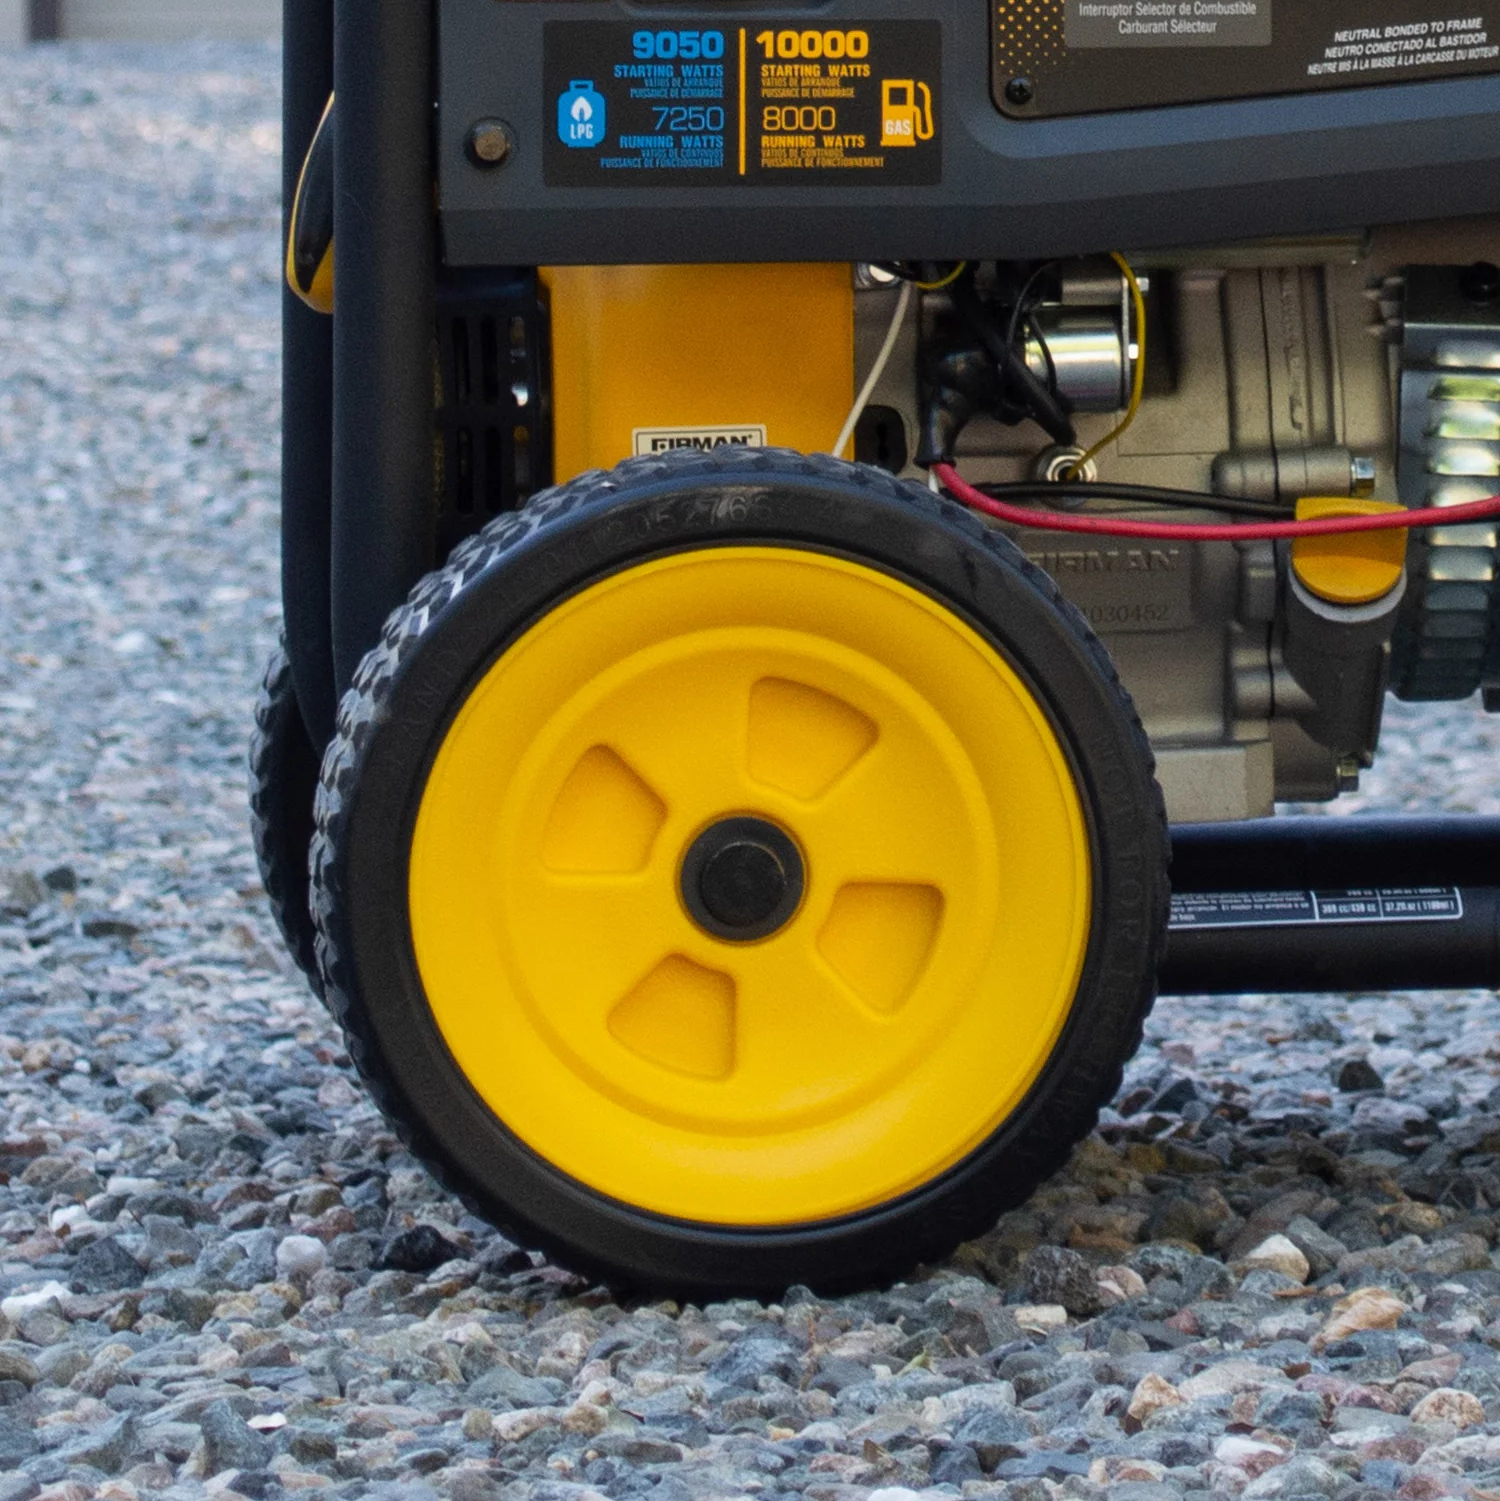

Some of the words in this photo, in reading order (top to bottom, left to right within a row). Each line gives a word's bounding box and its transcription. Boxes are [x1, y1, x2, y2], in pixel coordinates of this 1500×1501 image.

[1079, 3, 1133, 18] Interruptor
[1135, 3, 1177, 16] Selector
[1179, 2, 1192, 16] de
[1193, 1, 1257, 16] Combustible
[1118, 20, 1168, 34] Carburant
[1171, 19, 1217, 33] Sélecteur
[1334, 27, 1382, 42] NEUTRAL
[1384, 22, 1428, 38] BONDED
[1430, 21, 1445, 32] TO
[1446, 17, 1483, 32] FRAME
[633, 30, 724, 60] 9050
[756, 30, 869, 59] 10000
[1324, 44, 1363, 58] NEUTRO
[1365, 39, 1424, 56] CONECTADO
[1425, 37, 1437, 49] AL
[1439, 32, 1487, 47] BASTIDOR
[1308, 62, 1337, 75] NEUTRE
[1338, 61, 1352, 73] MIS
[1359, 58, 1370, 70] LA
[1371, 56, 1396, 69] MASSE
[1404, 54, 1414, 66] LA
[1415, 50, 1455, 65] CARCASSE
[1456, 48, 1467, 60] DU
[1468, 46, 1500, 59] MOTEUR
[613, 64, 674, 78] STARTING
[681, 64, 724, 78] WATTS
[761, 64, 821, 78] STARTING
[828, 64, 871, 78] WATTS
[652, 106, 725, 131] 7250
[763, 106, 836, 131] 8000
[570, 124, 593, 140] LPG
[885, 120, 911, 136] GAS
[619, 135, 673, 148] RUNNING
[681, 135, 724, 148] WATTS
[761, 135, 816, 148] RUNNING
[823, 135, 866, 148] WATTS
